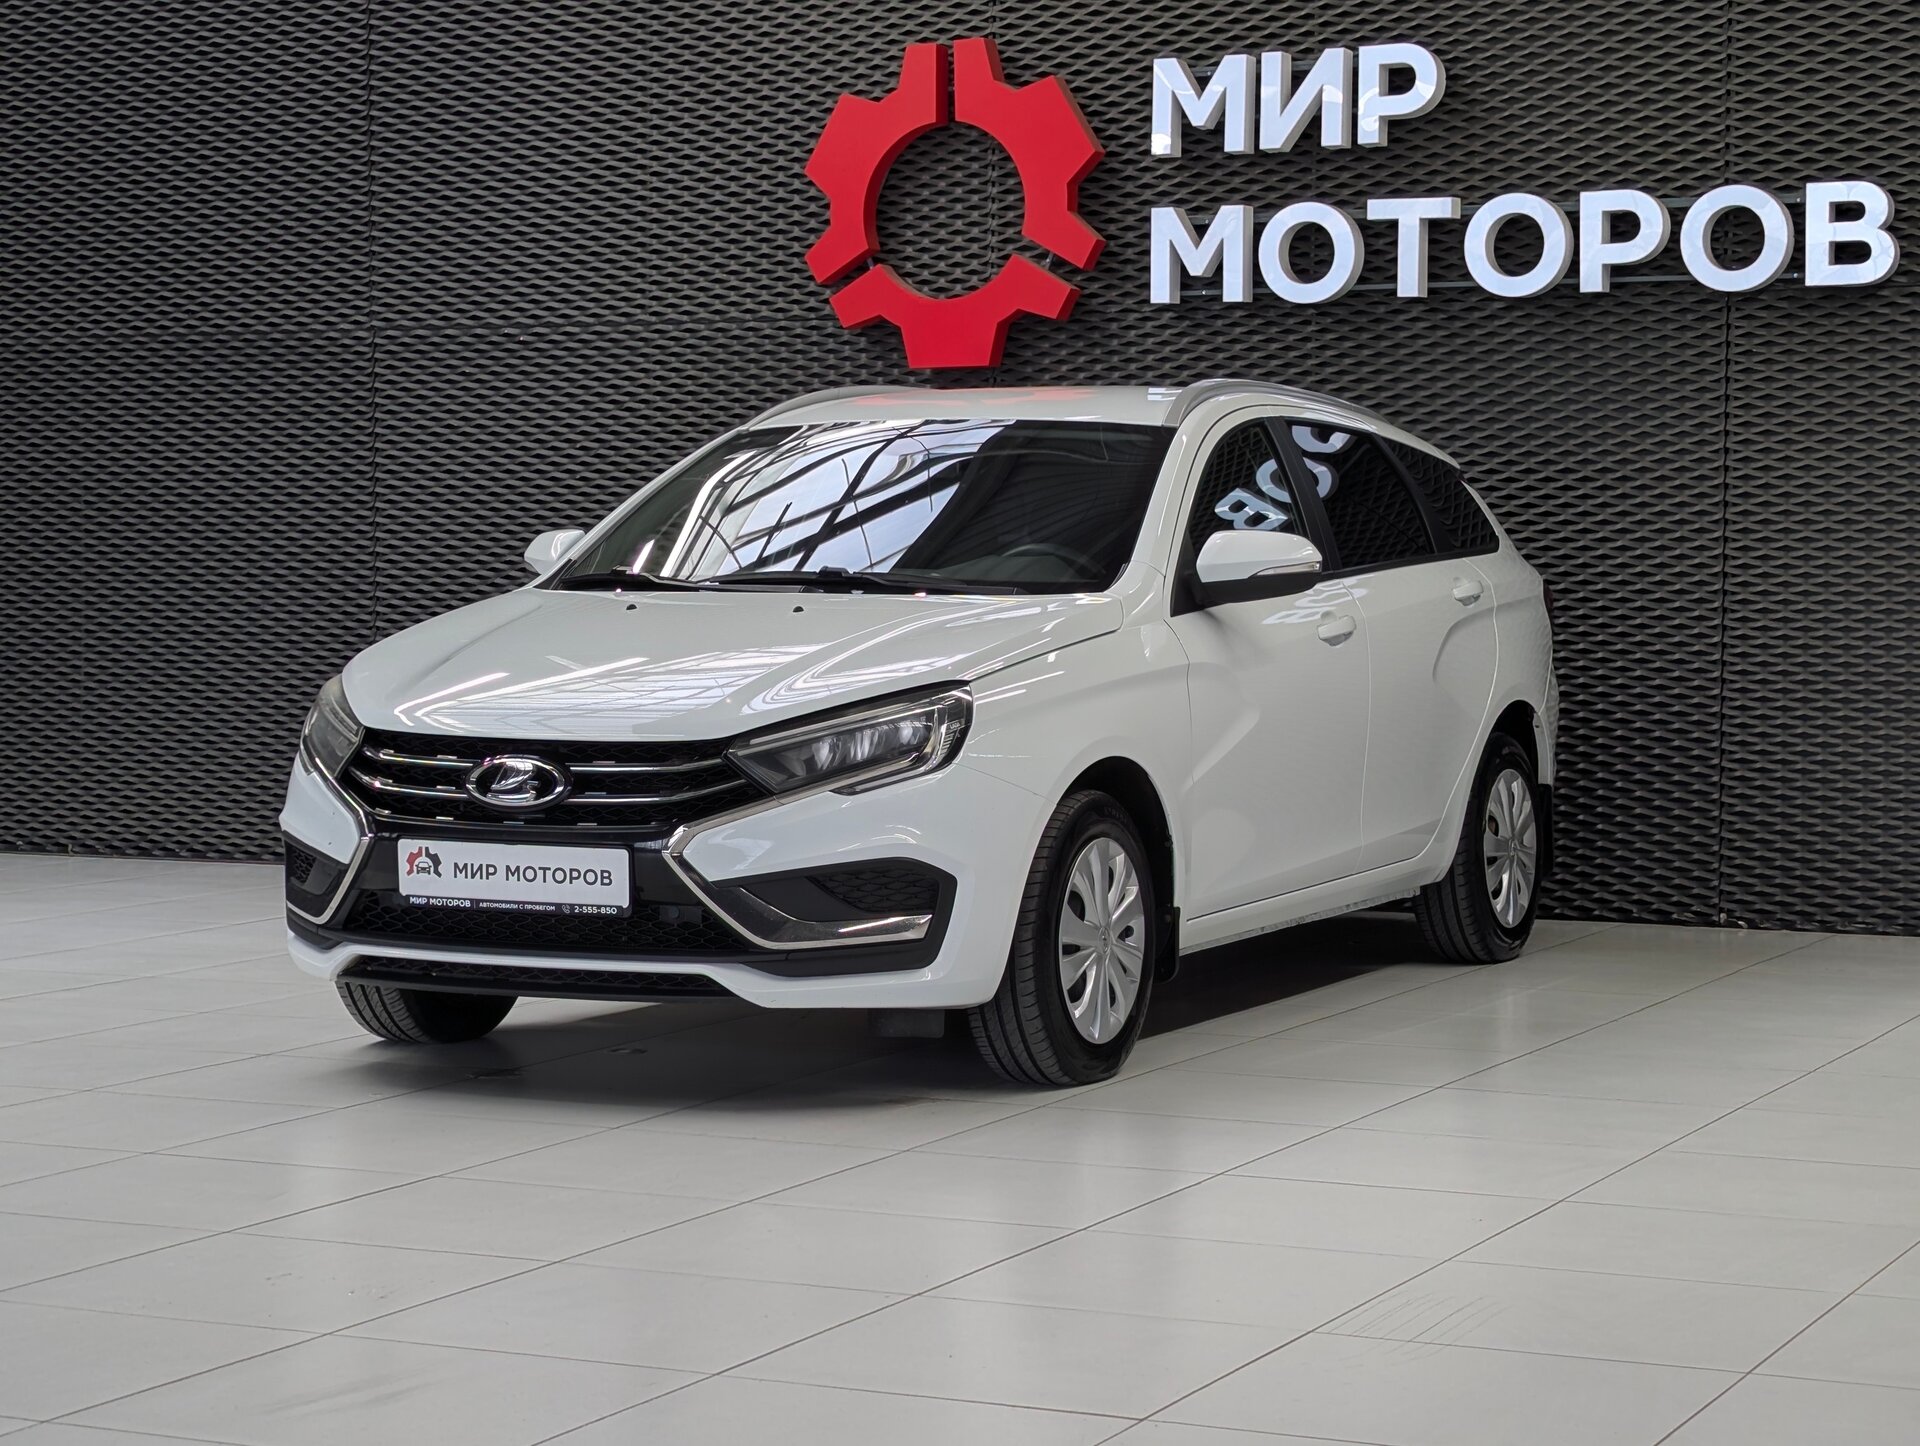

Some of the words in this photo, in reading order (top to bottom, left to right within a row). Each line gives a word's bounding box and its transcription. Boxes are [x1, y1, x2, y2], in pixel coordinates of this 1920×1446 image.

[1151, 42, 1446, 157] МИР
[1149, 180, 1899, 305] МОТОРОВ
[409, 896, 428, 905] МИР
[429, 897, 471, 908] МОТОРОВ
[524, 904, 556, 912] ПРОБЕГОМ
[574, 905, 618, 915] 2-555-850
[453, 861, 498, 881] МИР
[505, 864, 613, 887] МОТОРОВ
